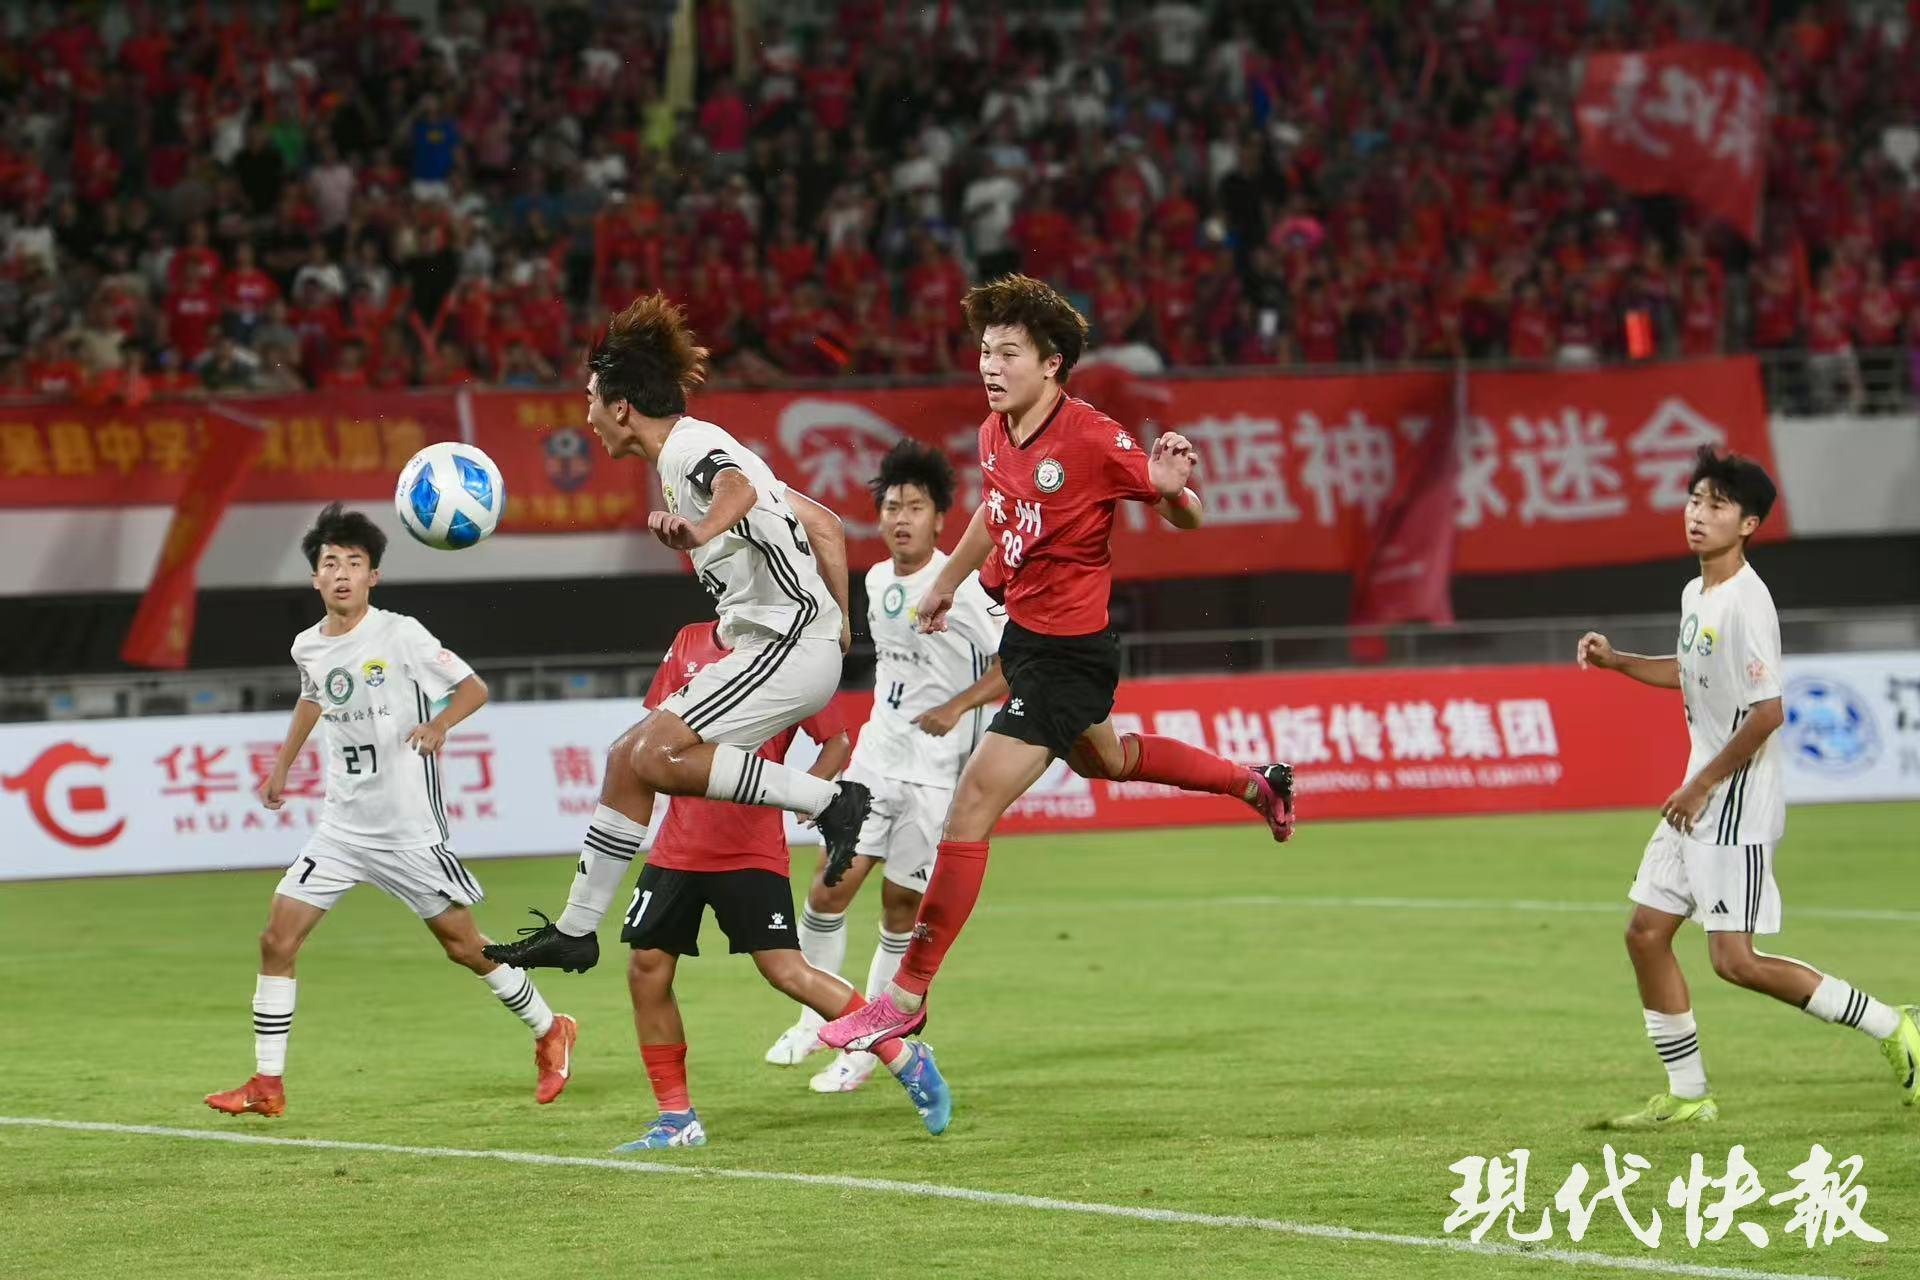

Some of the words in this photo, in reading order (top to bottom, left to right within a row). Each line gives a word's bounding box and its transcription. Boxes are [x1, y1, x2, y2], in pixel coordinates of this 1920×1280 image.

[987, 488, 1042, 538] 苏州
[1001, 530, 1023, 569] 28
[887, 681, 904, 710] 4
[1112, 699, 1559, 765] 出版传媒集团
[155, 733, 497, 804] 华夏行
[343, 744, 377, 774] 27
[174, 809, 318, 834] HUAXI
[624, 887, 652, 928] 21
